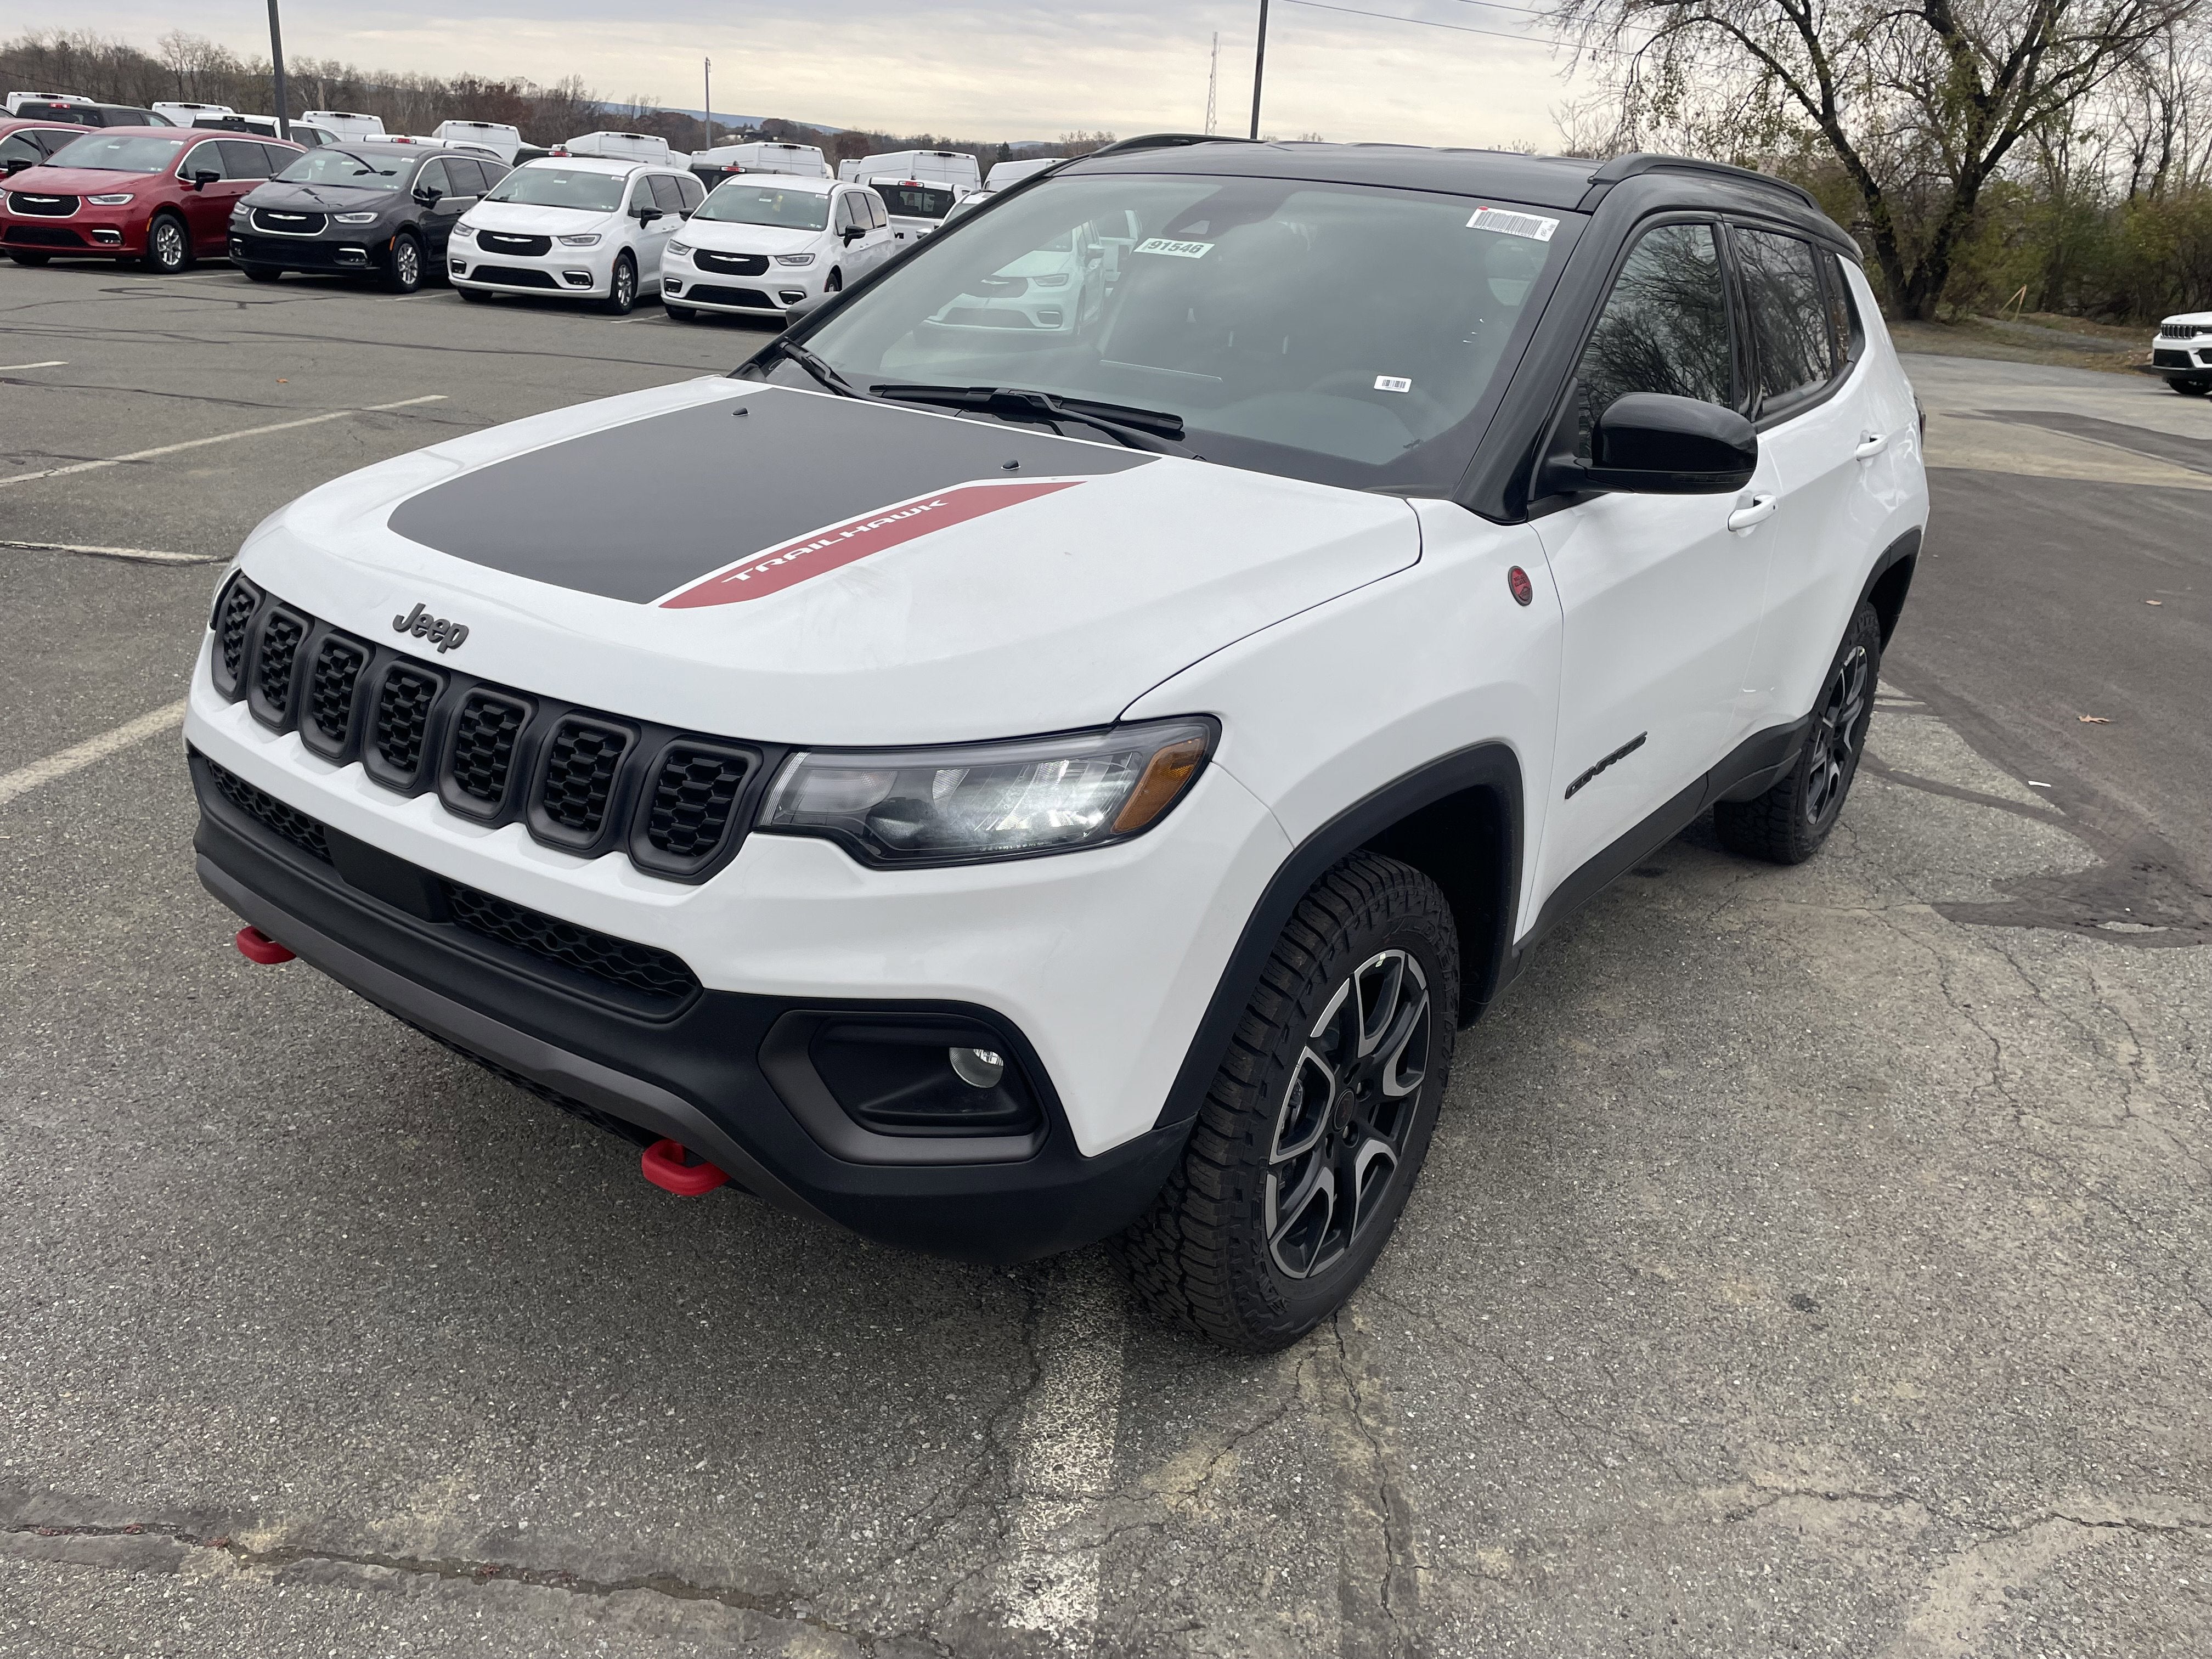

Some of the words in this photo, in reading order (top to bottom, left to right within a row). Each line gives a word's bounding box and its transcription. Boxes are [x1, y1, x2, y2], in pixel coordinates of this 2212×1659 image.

[1148, 241, 1204, 253] 91546
[721, 499, 950, 584] TRAILHAWK
[392, 602, 469, 654] Jeep
